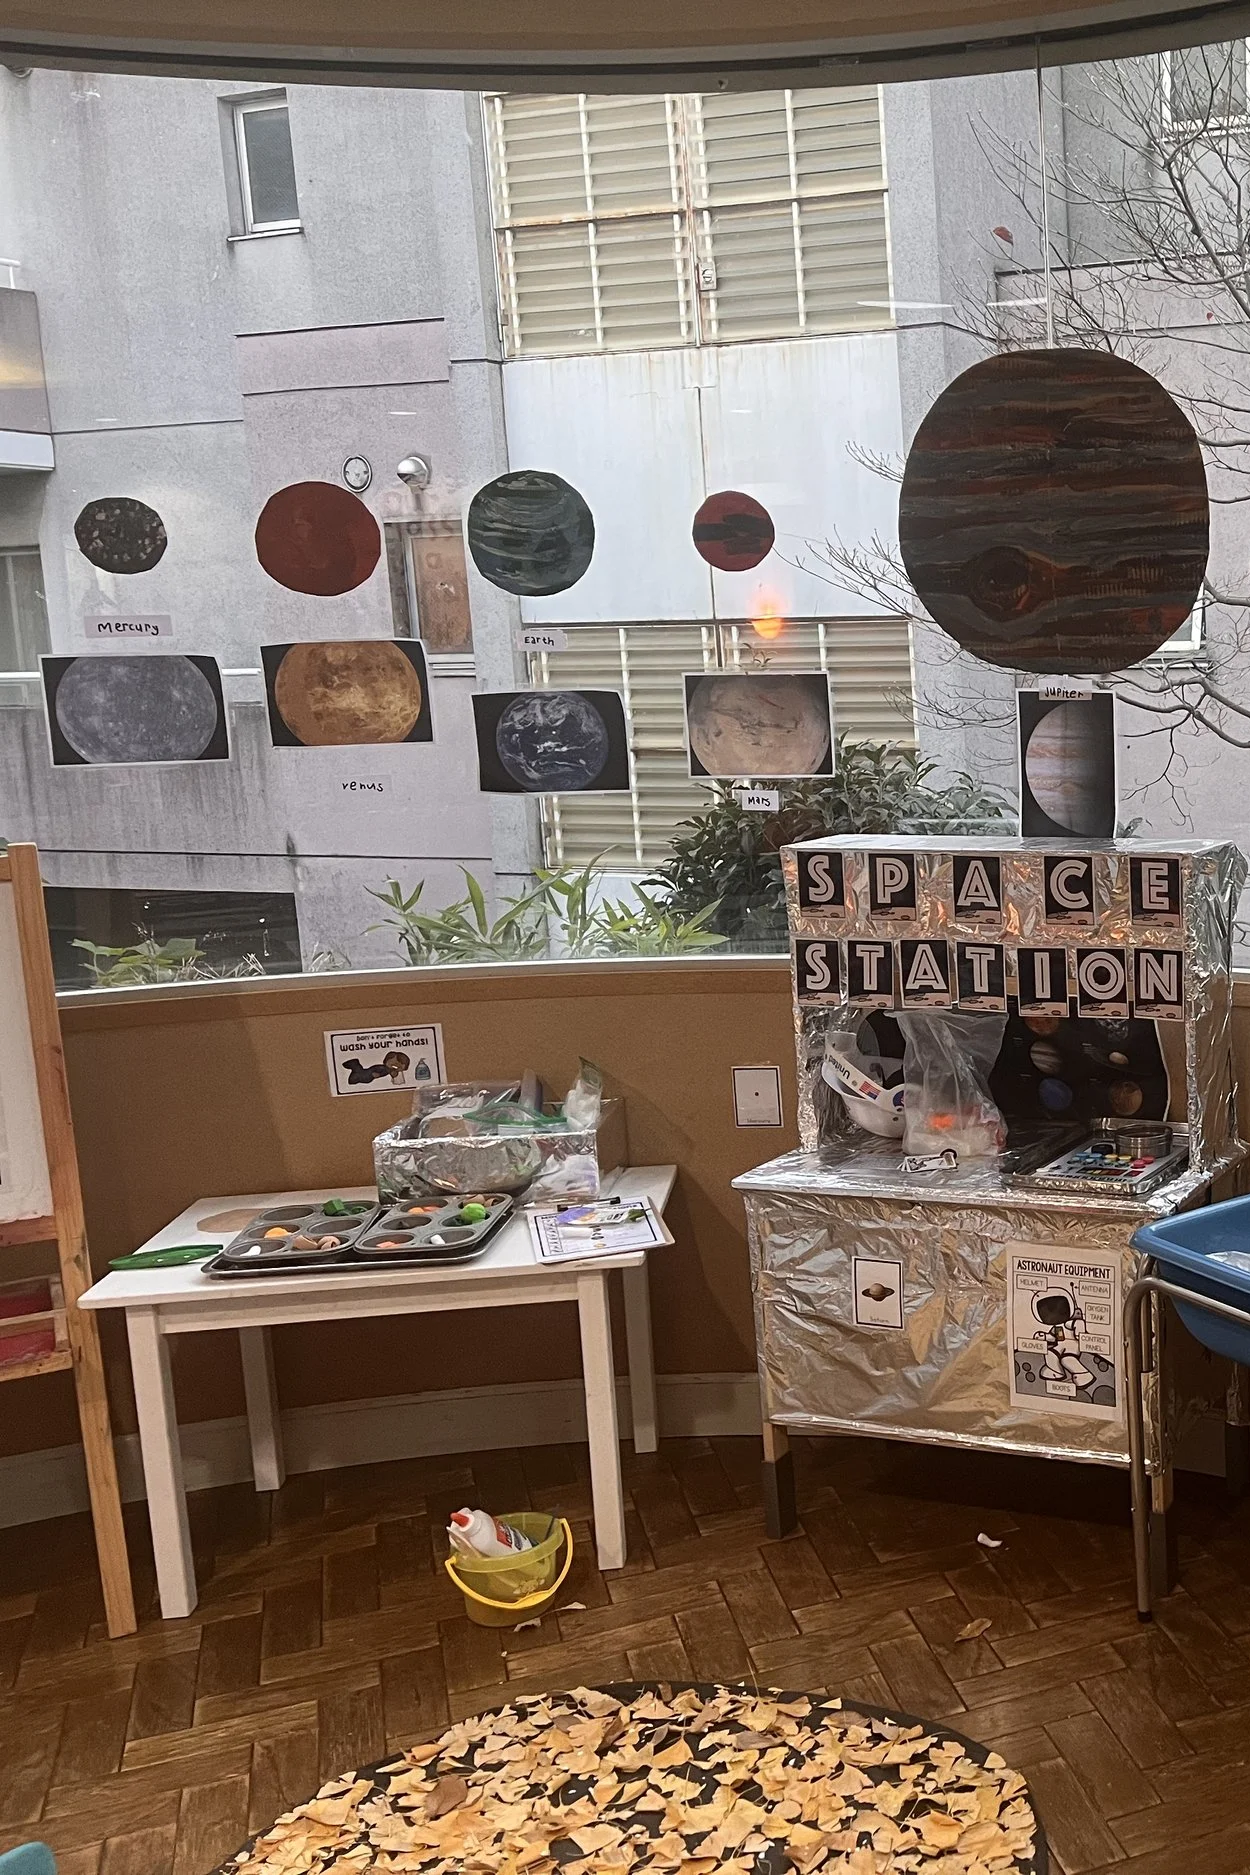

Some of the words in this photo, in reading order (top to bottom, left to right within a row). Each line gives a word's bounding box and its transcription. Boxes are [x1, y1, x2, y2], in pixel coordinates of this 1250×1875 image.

[97, 622, 159, 636] Mercury
[524, 636, 555, 646] Earth
[1044, 686, 1084, 699] Jupiter
[747, 796, 771, 807] Mars
[807, 854, 1171, 911] SPACE
[805, 942, 1178, 1001] STATION
[1016, 1259, 1063, 1275] ASTRONAUT
[1064, 1264, 1111, 1280] EQUIPMENT
